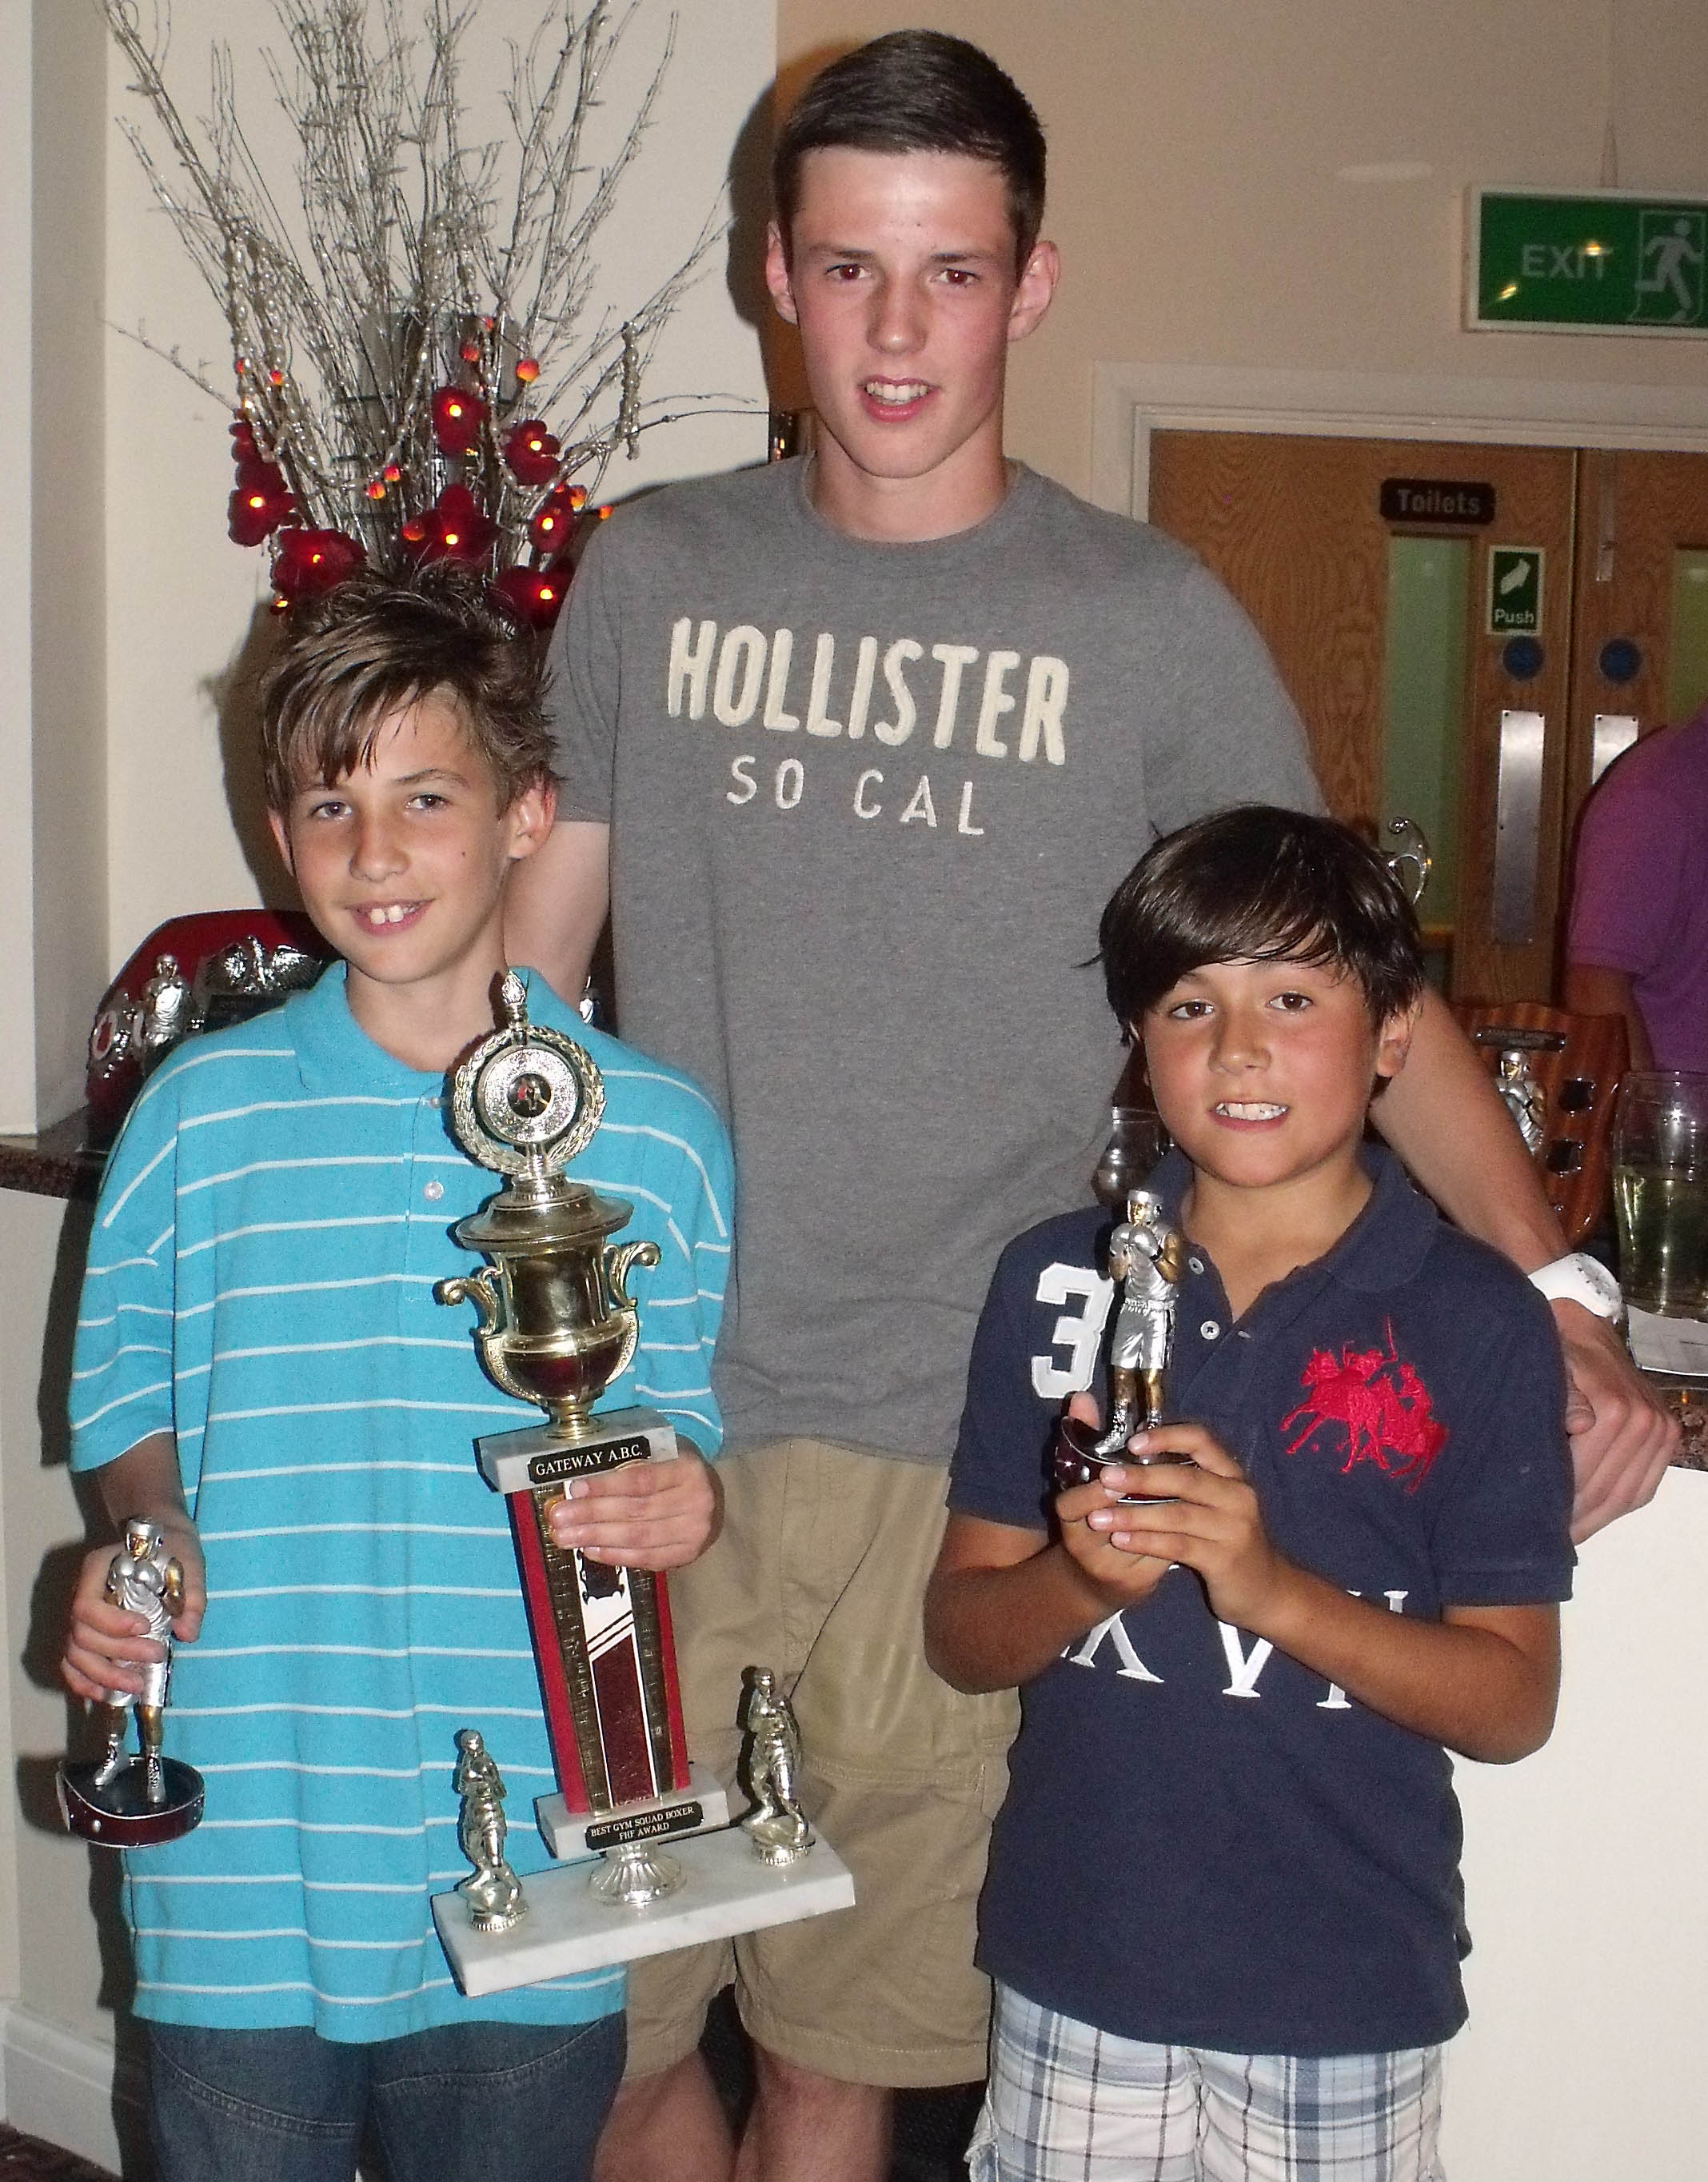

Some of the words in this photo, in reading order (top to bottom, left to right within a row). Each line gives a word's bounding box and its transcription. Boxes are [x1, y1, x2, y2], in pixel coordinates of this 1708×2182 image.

[1522, 244, 1614, 279] EXIT
[1398, 488, 1479, 514] Toilets
[1494, 609, 1534, 623] Push
[667, 617, 1069, 765] HOLLISTER
[726, 754, 804, 810] SO
[853, 769, 984, 836] CAL
[1032, 1262, 1115, 1399] 3
[536, 1452, 603, 1476] GATEWAY
[590, 1824, 611, 1837] BEST
[613, 1821, 633, 1832] GYM
[634, 1813, 664, 1828] SQUAD
[665, 1806, 694, 1820] BOXER
[637, 1822, 670, 1837] AWARD
